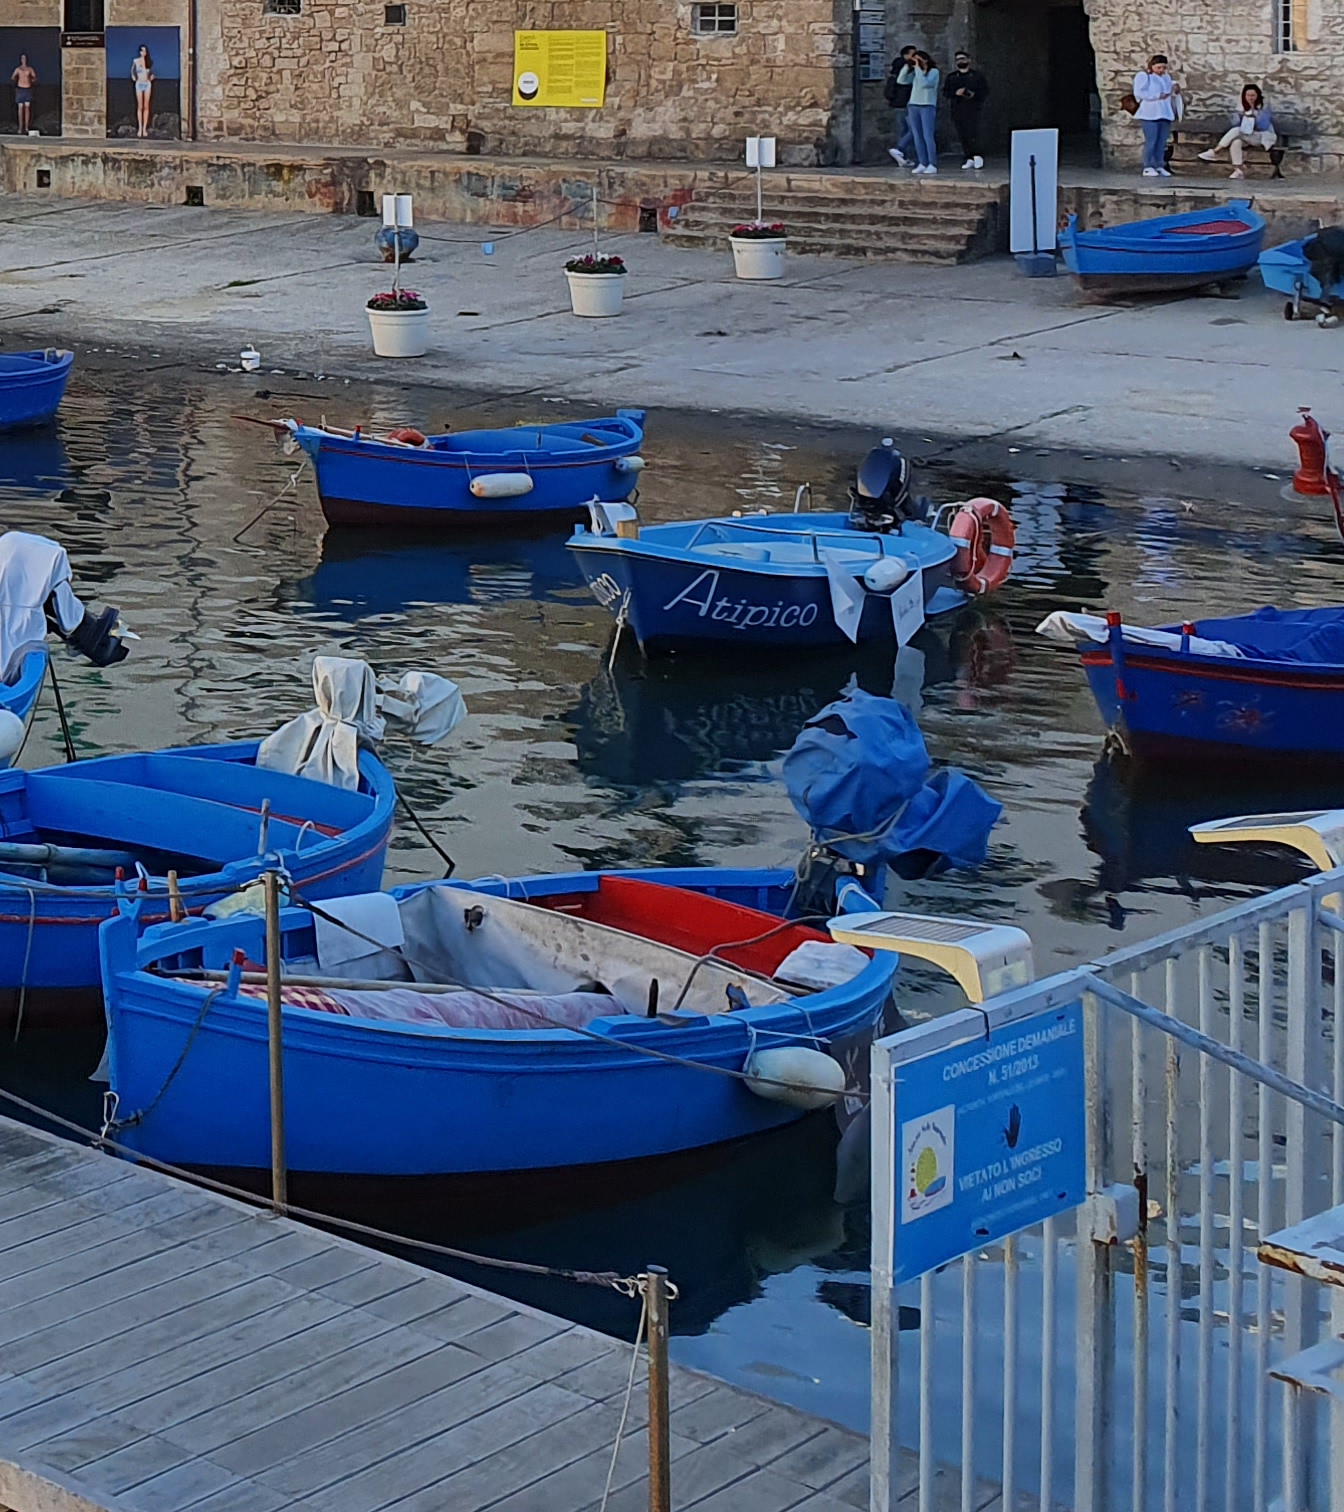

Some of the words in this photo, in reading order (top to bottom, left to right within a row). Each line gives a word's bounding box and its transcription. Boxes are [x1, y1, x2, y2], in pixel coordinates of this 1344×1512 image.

[663, 570, 818, 630] Atipico
[943, 1041, 1017, 1081] CONCESSIONE
[959, 1161, 1002, 1191] VIETATO
[994, 1176, 1016, 1198] NON
[1018, 1166, 1042, 1188] SOCI
